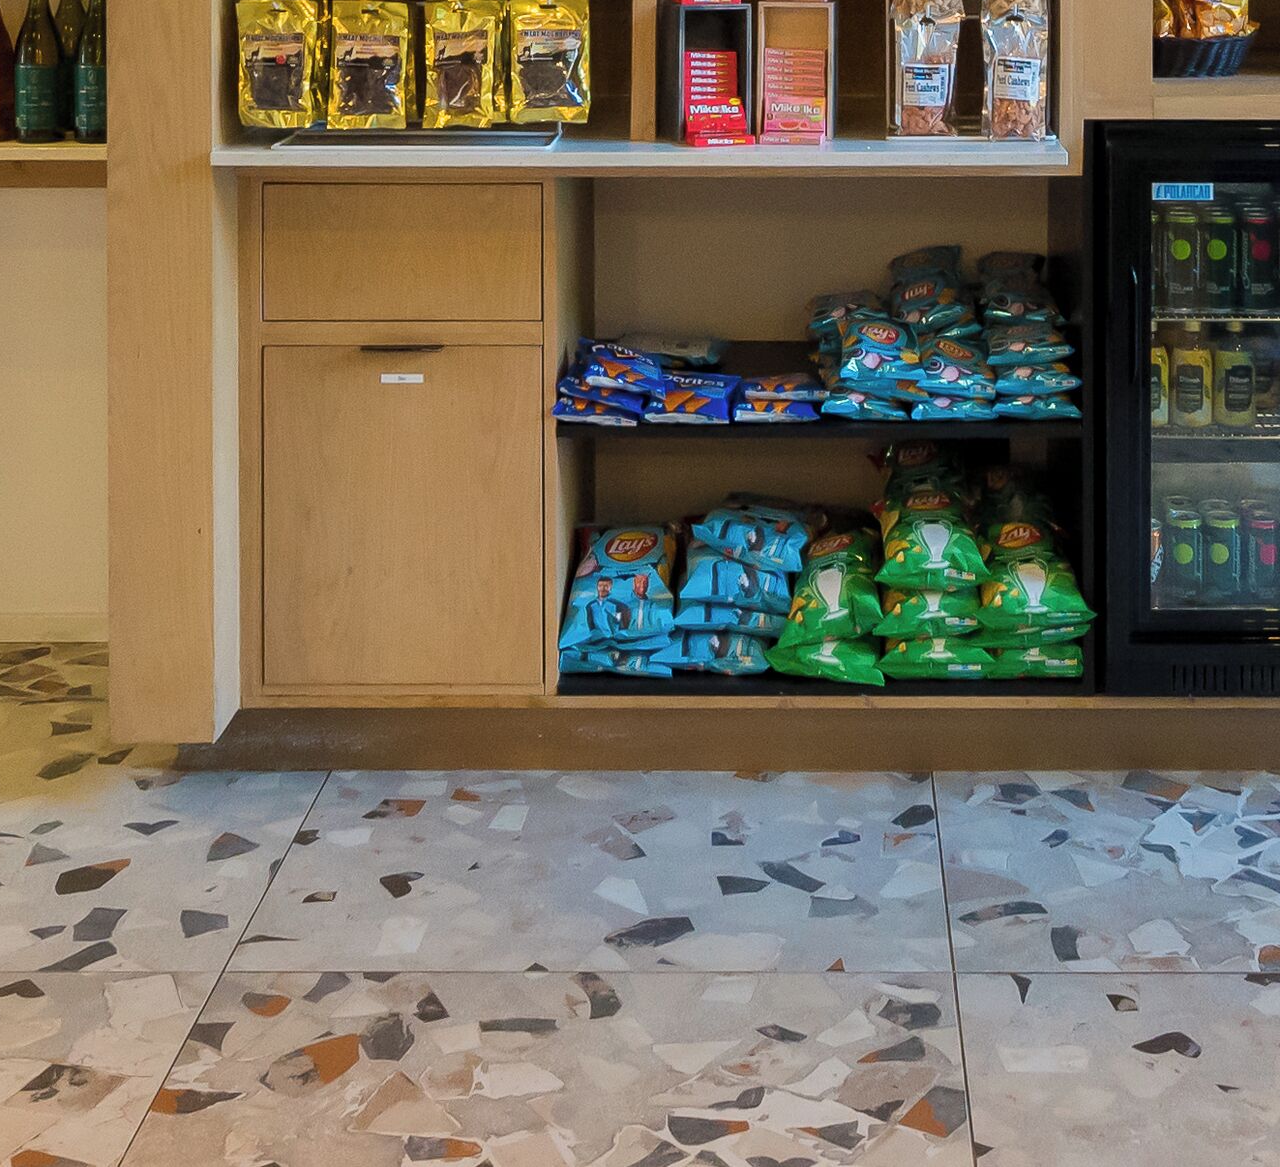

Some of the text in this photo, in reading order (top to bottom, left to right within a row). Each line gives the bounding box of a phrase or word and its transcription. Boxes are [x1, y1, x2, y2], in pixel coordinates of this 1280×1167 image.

[690, 104, 739, 114] Mike Ike
[771, 103, 800, 112] Mike
[610, 538, 655, 557] Lay's
